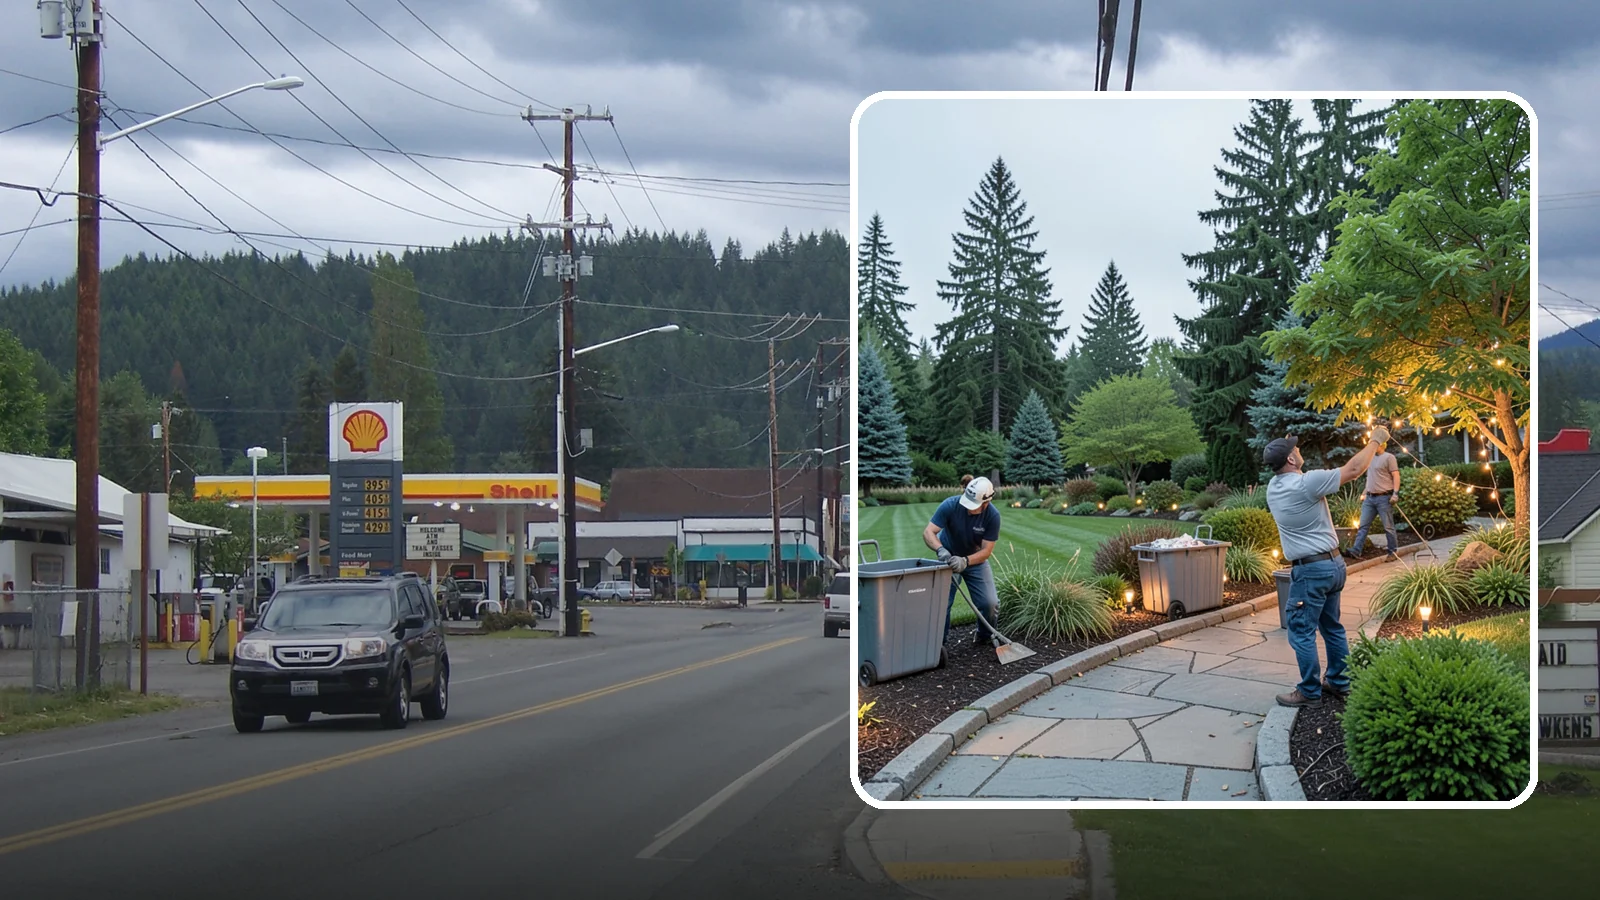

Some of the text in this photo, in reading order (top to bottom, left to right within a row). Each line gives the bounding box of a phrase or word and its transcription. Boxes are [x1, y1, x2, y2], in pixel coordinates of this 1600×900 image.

[366, 480, 384, 490] 395
[490, 484, 547, 499] Shell
[366, 494, 384, 504] 405
[366, 508, 384, 518] 415
[366, 522, 384, 532] 429
[1538, 643, 1566, 665] AID
